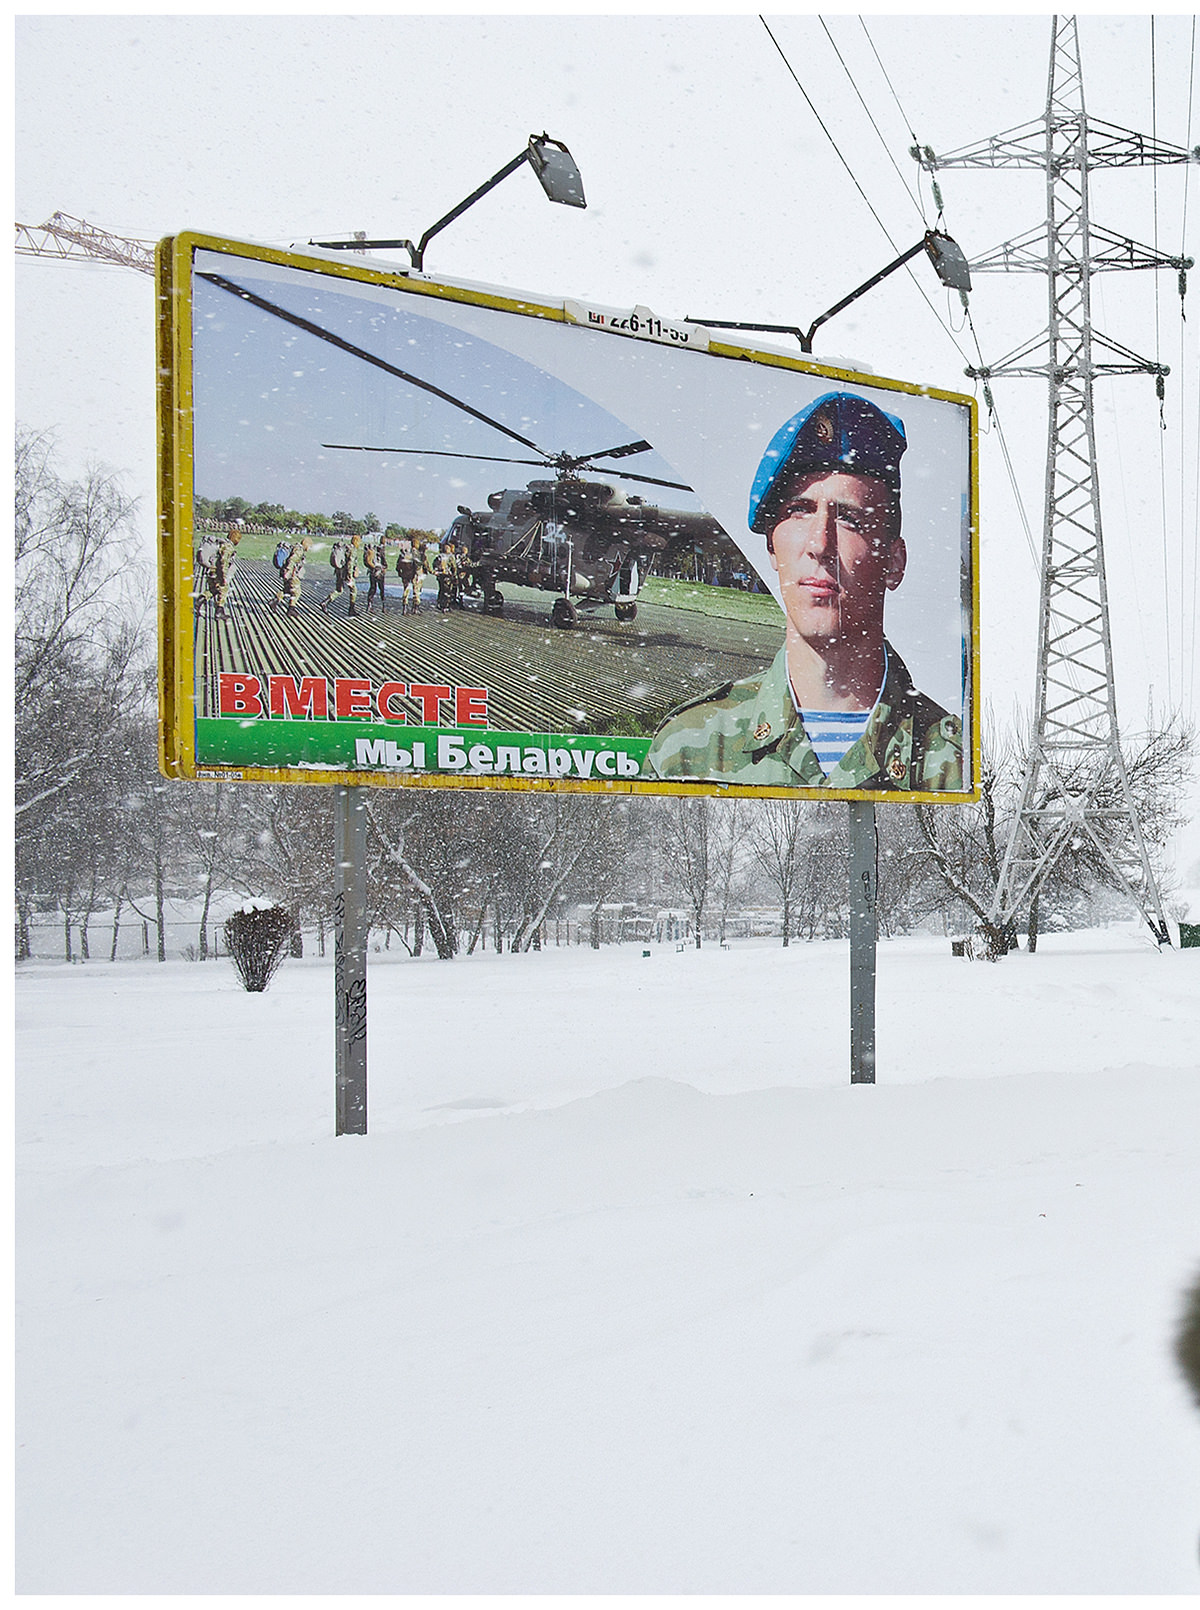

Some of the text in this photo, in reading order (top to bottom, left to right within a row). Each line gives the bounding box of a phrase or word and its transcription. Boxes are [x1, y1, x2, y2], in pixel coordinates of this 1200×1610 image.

[219, 672, 489, 729] ВМЕСТЕ
[354, 735, 640, 777] мы Беларусь
